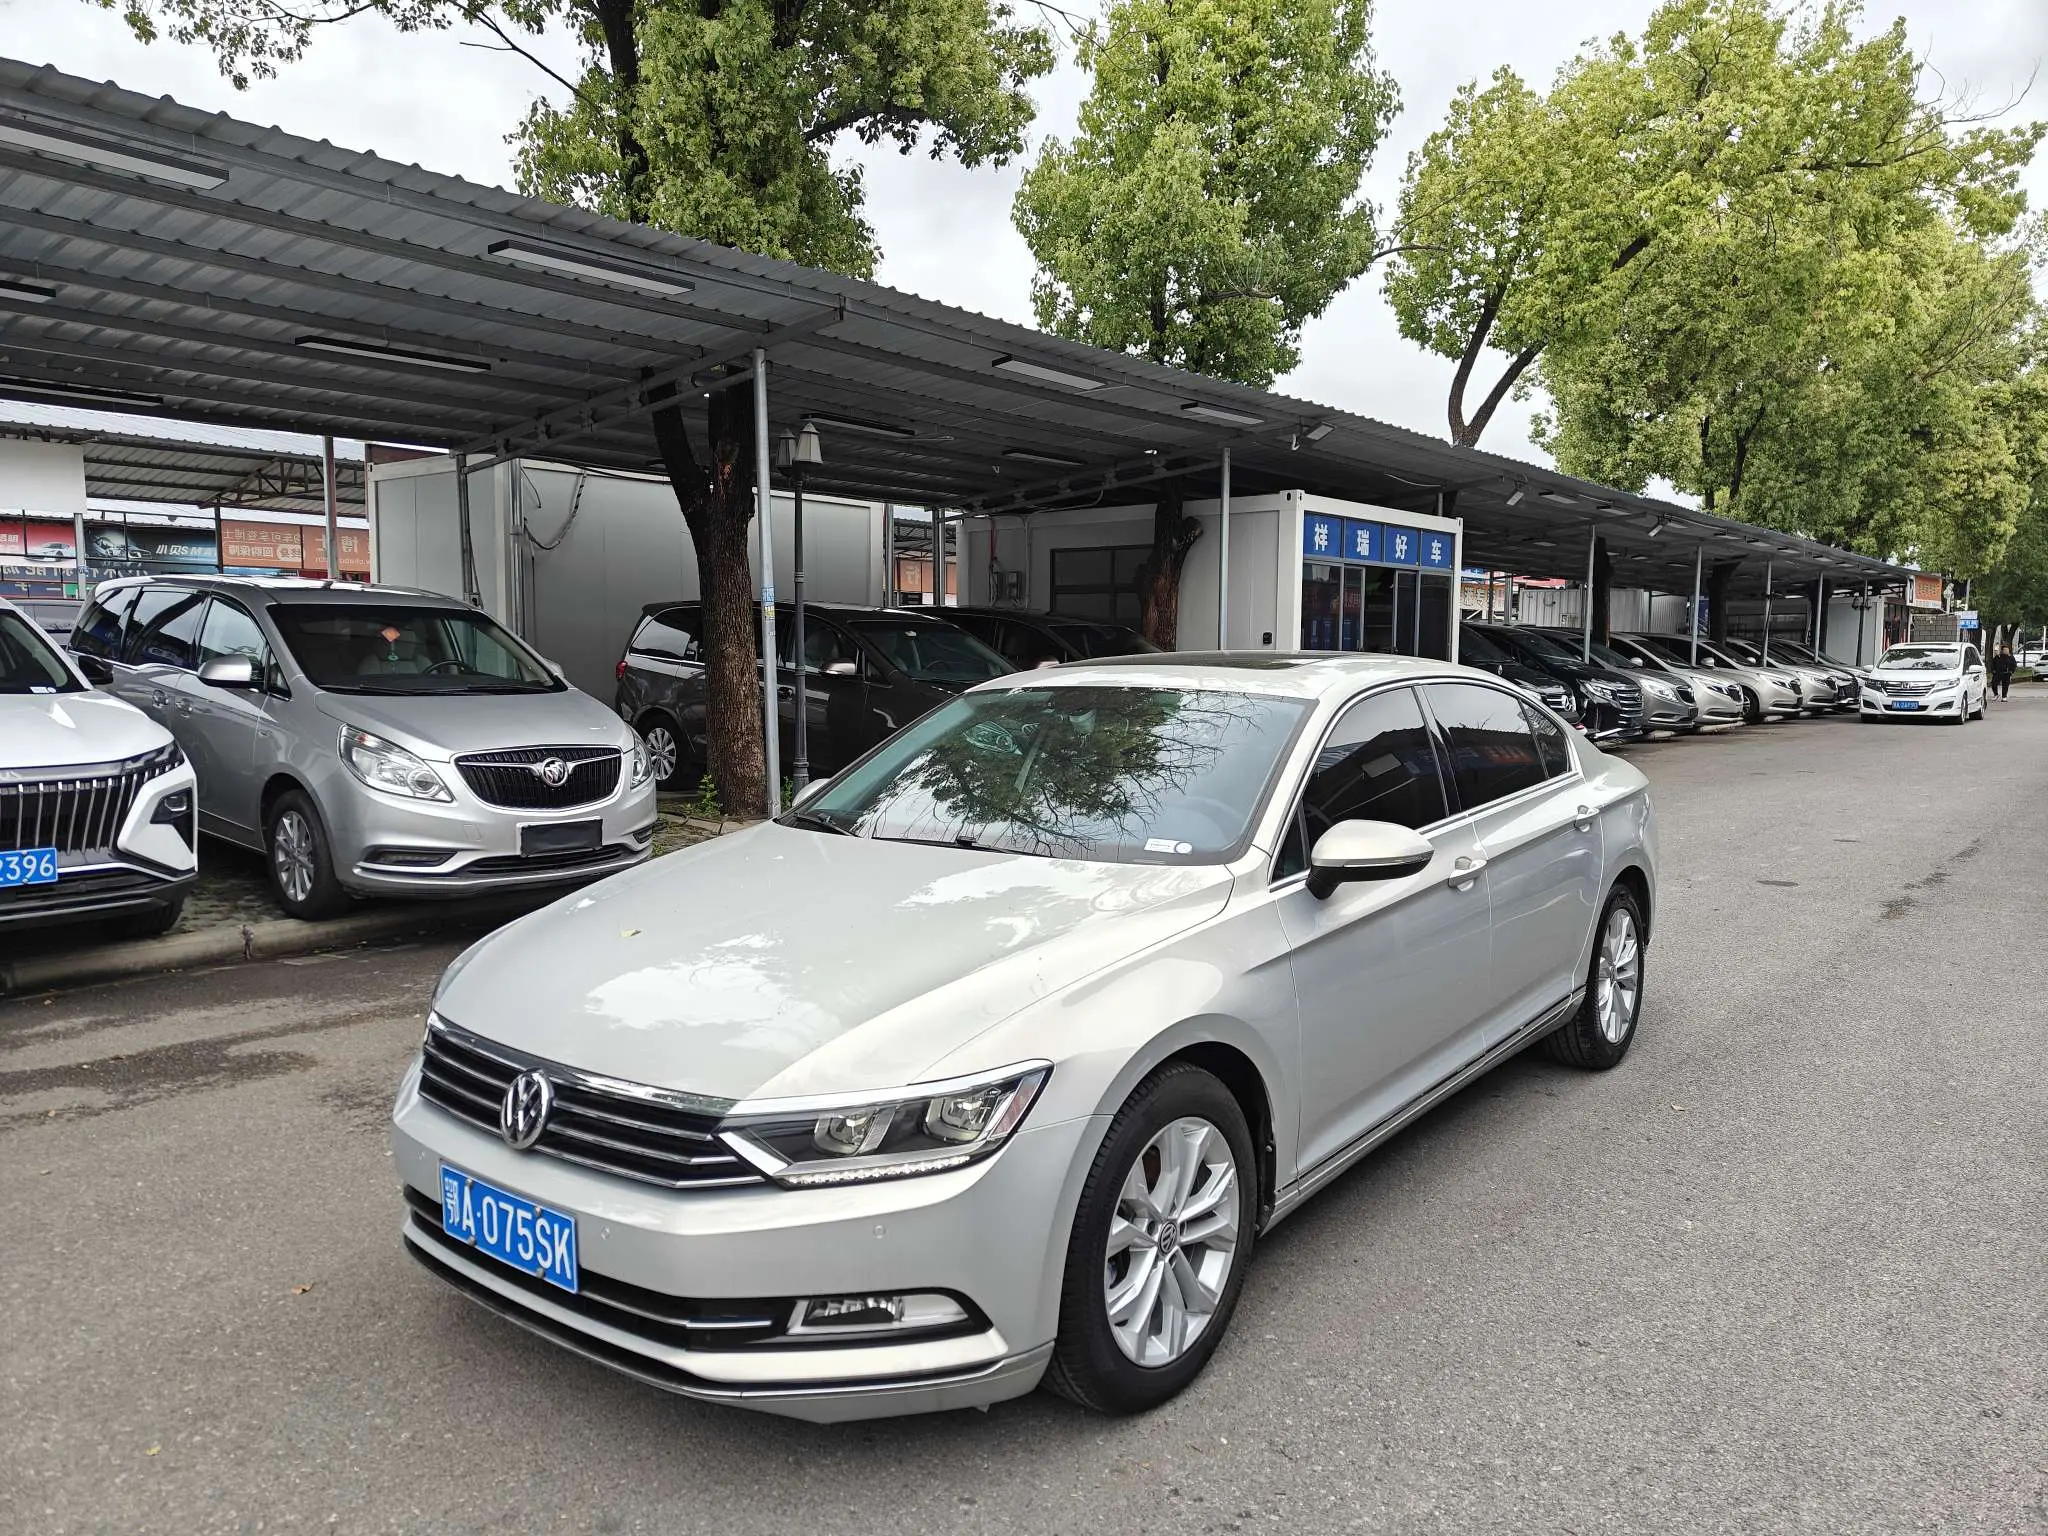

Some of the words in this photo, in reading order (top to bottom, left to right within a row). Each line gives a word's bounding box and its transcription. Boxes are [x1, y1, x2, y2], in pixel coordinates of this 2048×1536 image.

[1314, 523, 1442, 564] 祥瑞好车
[0, 853, 54, 882] 396
